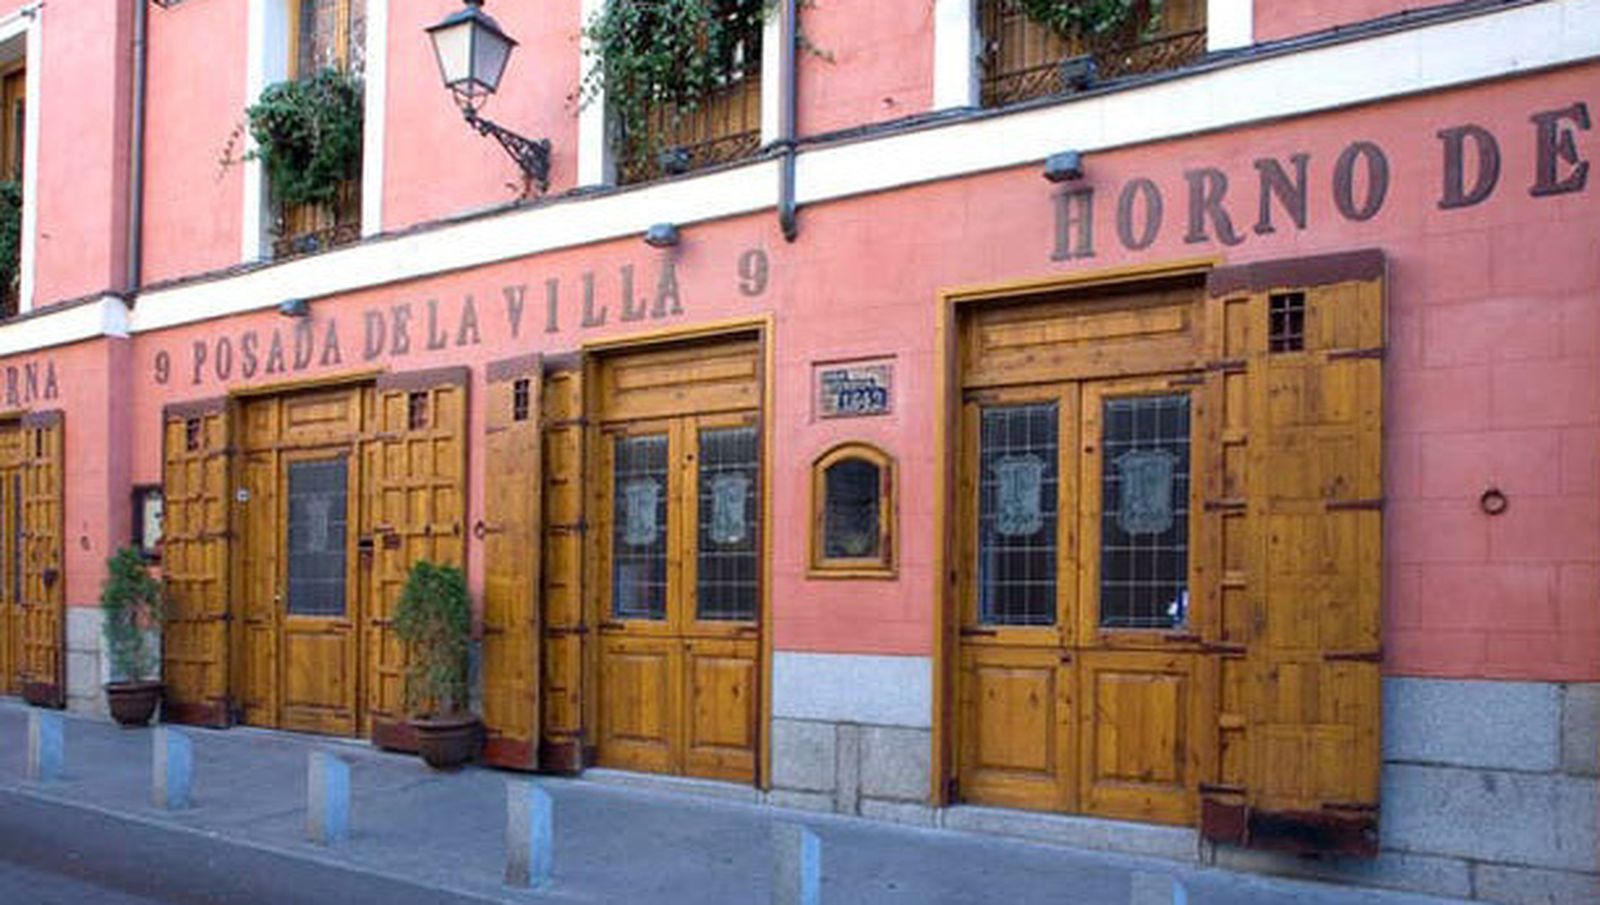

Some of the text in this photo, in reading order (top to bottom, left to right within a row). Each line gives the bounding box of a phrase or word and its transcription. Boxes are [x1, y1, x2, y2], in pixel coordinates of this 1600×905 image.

[1050, 101, 1591, 261] HORNO DE
[154, 248, 770, 385] 9 POSADA DE LA VILLA 9
